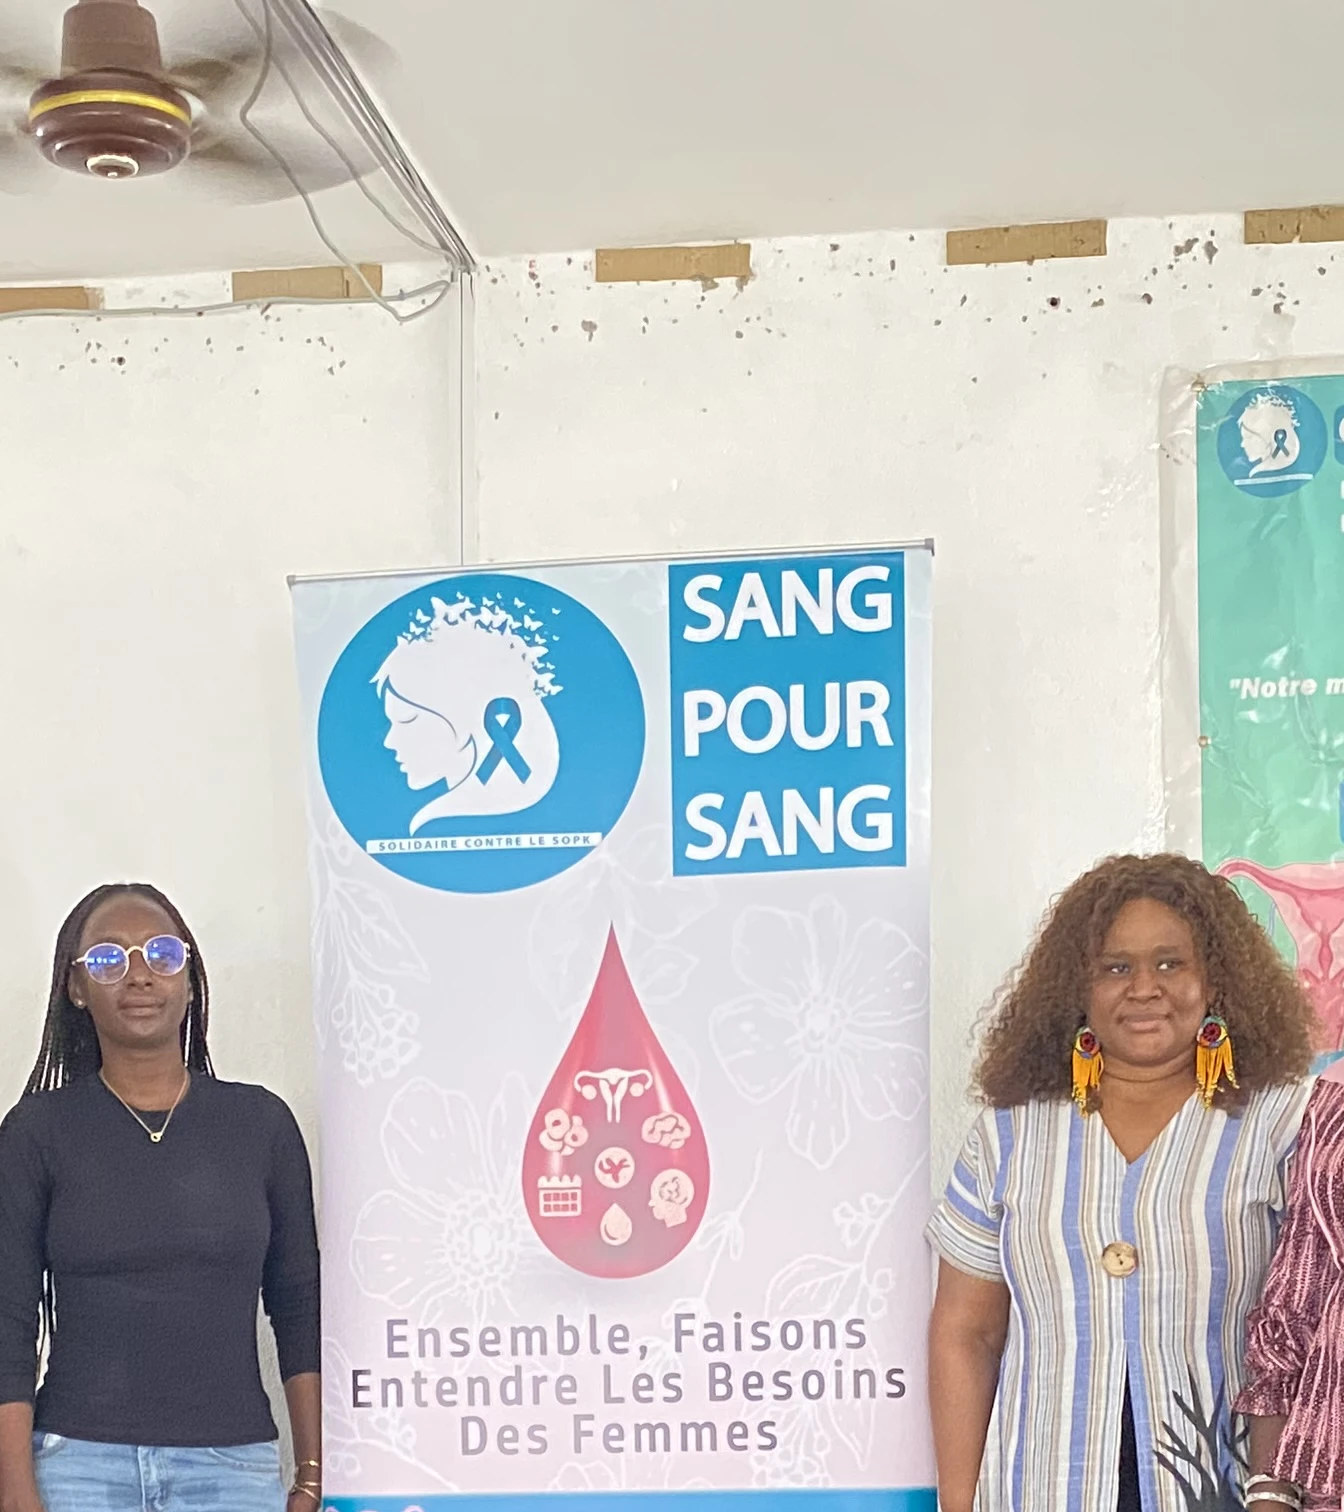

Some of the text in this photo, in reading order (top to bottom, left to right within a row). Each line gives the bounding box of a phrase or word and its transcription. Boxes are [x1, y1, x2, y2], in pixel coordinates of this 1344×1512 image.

[682, 566, 893, 644] SANG
[1229, 676, 1317, 700] "Notre
[683, 680, 894, 758] POUR
[378, 835, 591, 851] SOLIDAIRE CONTRE LE SOPK
[685, 785, 893, 861] SANG
[386, 1311, 866, 1361] Ensemble, Faisons
[352, 1359, 906, 1409] Entendre Les Besoins
[461, 1414, 778, 1456] Des Femmes
